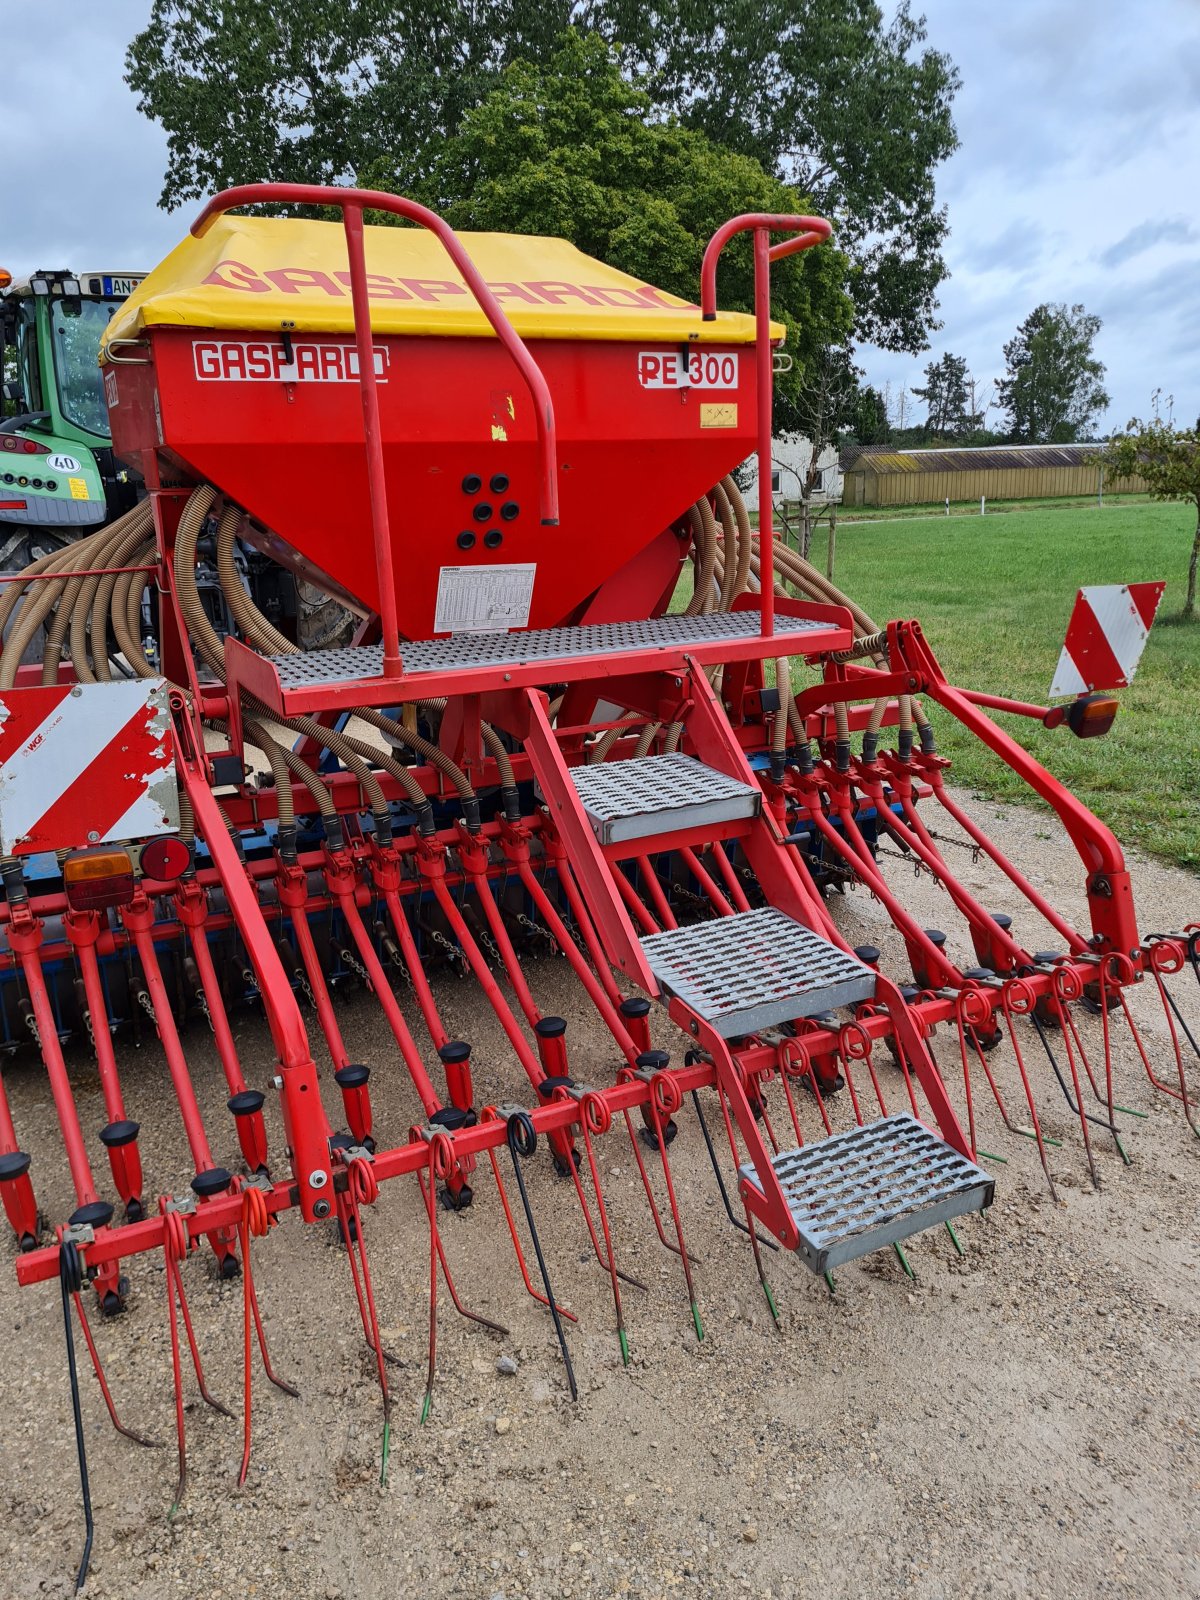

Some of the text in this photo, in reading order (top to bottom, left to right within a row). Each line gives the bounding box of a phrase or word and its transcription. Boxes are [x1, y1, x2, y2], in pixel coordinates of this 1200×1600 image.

[113, 280, 130, 293] AN
[641, 356, 735, 385] RE 300
[54, 457, 75, 469] 40
